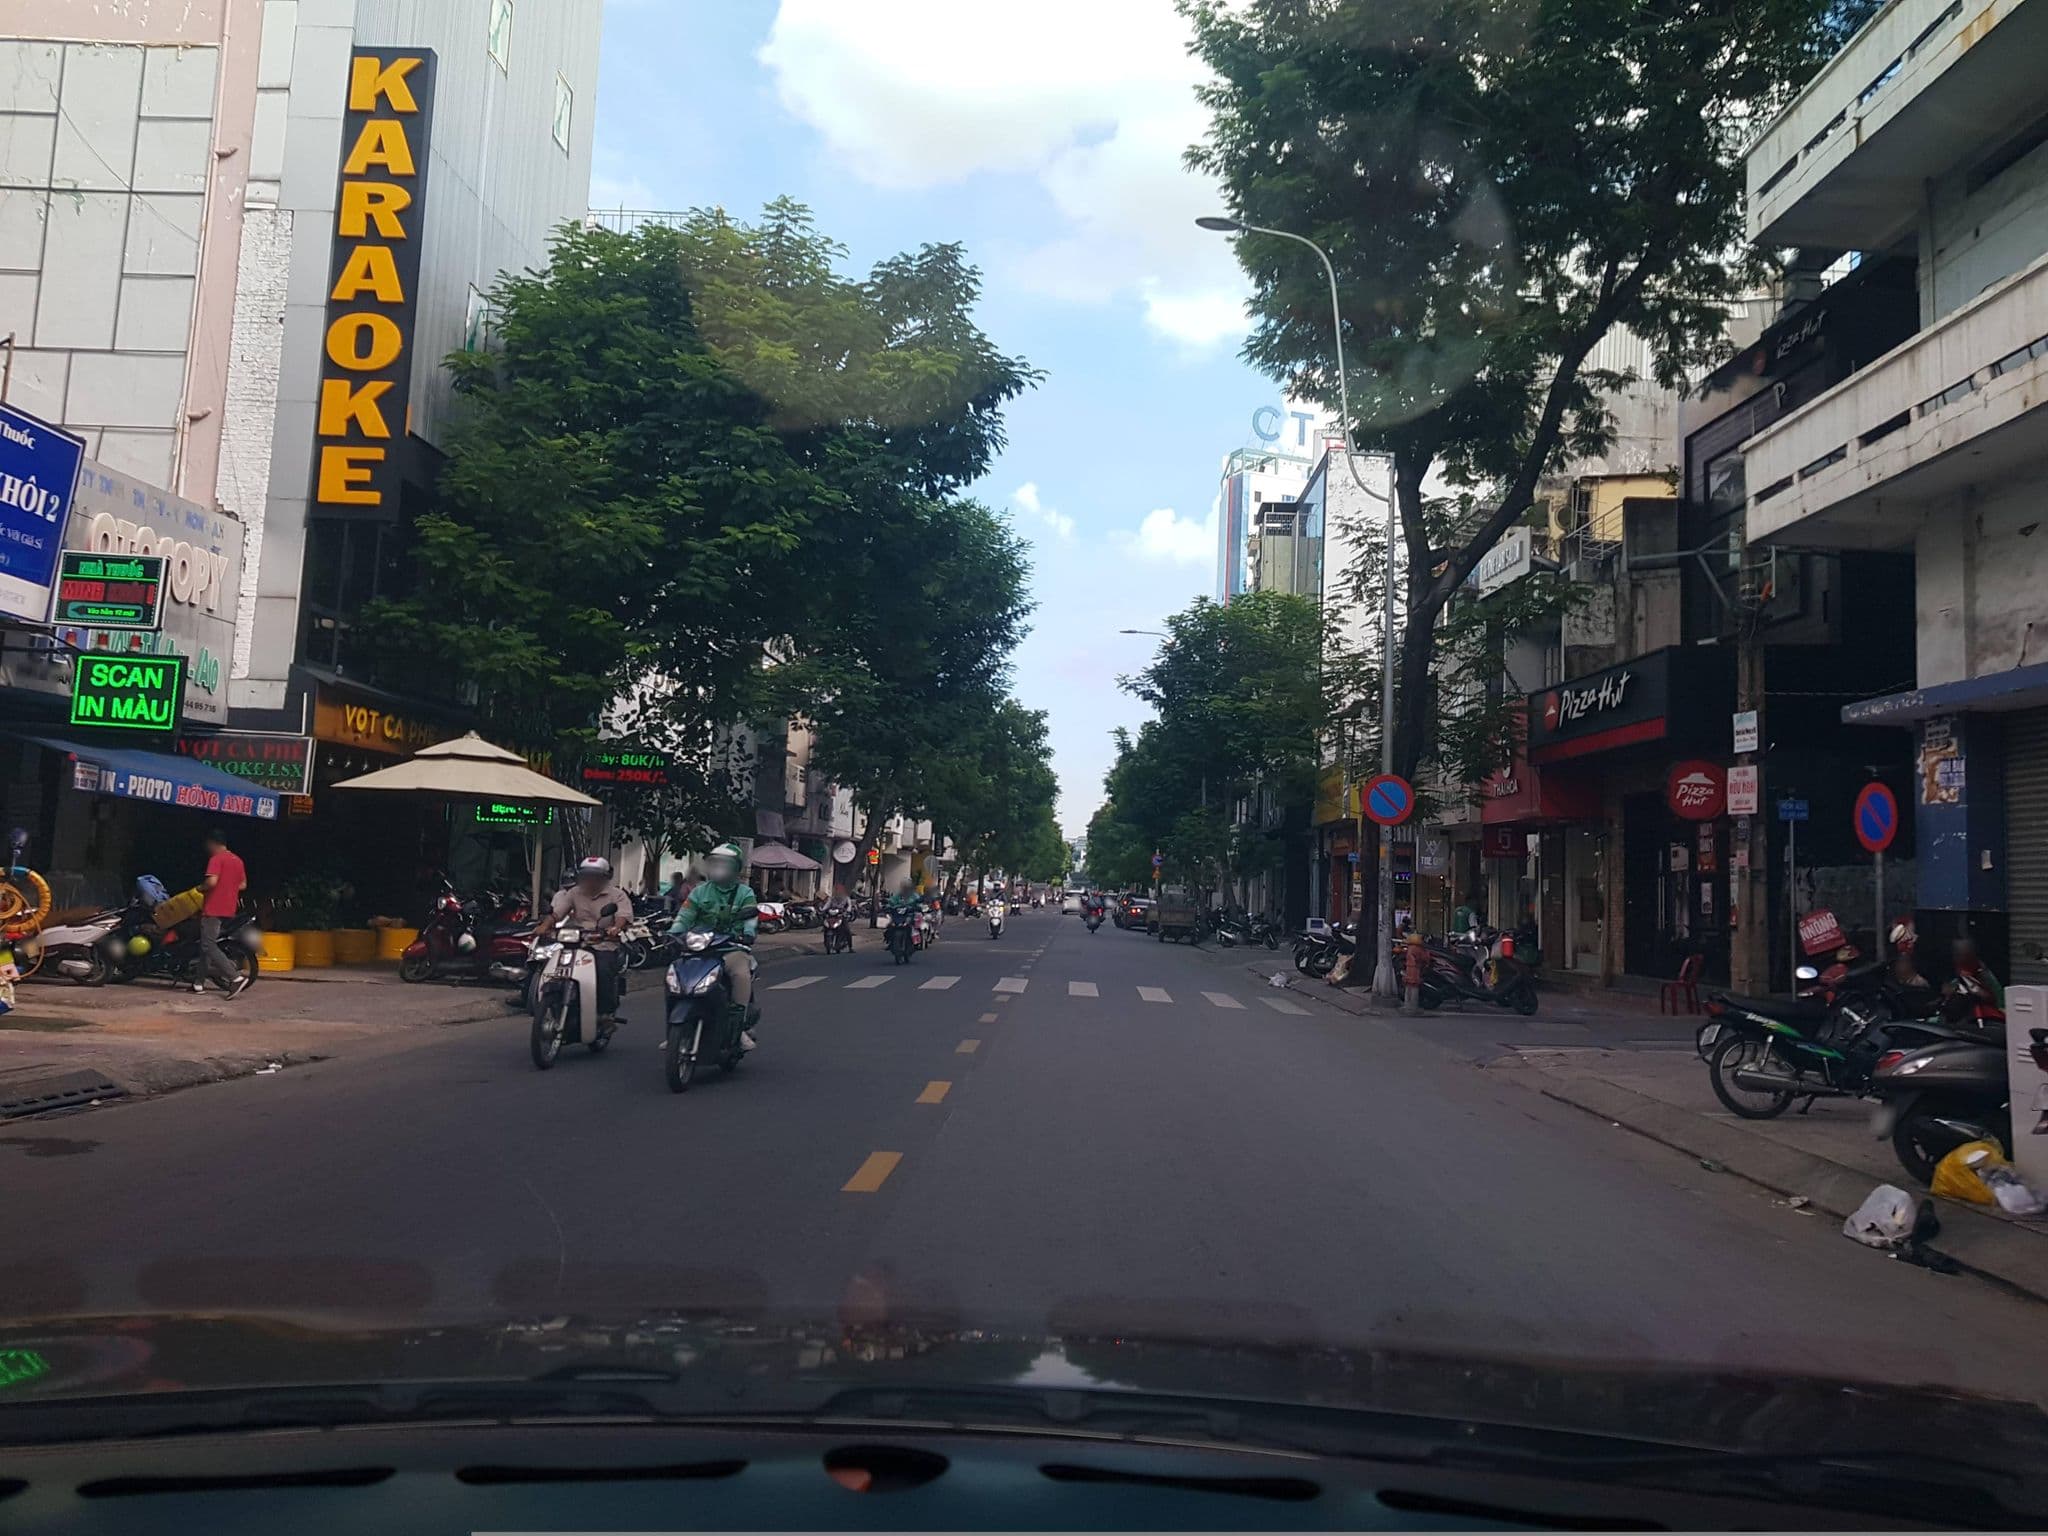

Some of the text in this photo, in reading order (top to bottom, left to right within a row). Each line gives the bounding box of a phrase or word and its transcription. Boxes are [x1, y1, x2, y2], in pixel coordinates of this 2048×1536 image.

[317, 56, 425, 506] KARAOKE
[90, 663, 164, 689] SCAN
[78, 693, 170, 722] IN MÀU
[1559, 671, 1632, 728] Pizza Hut
[127, 774, 173, 802] PHOTO
[1676, 783, 1715, 800] Pizza
[1682, 796, 1711, 808] Hut
